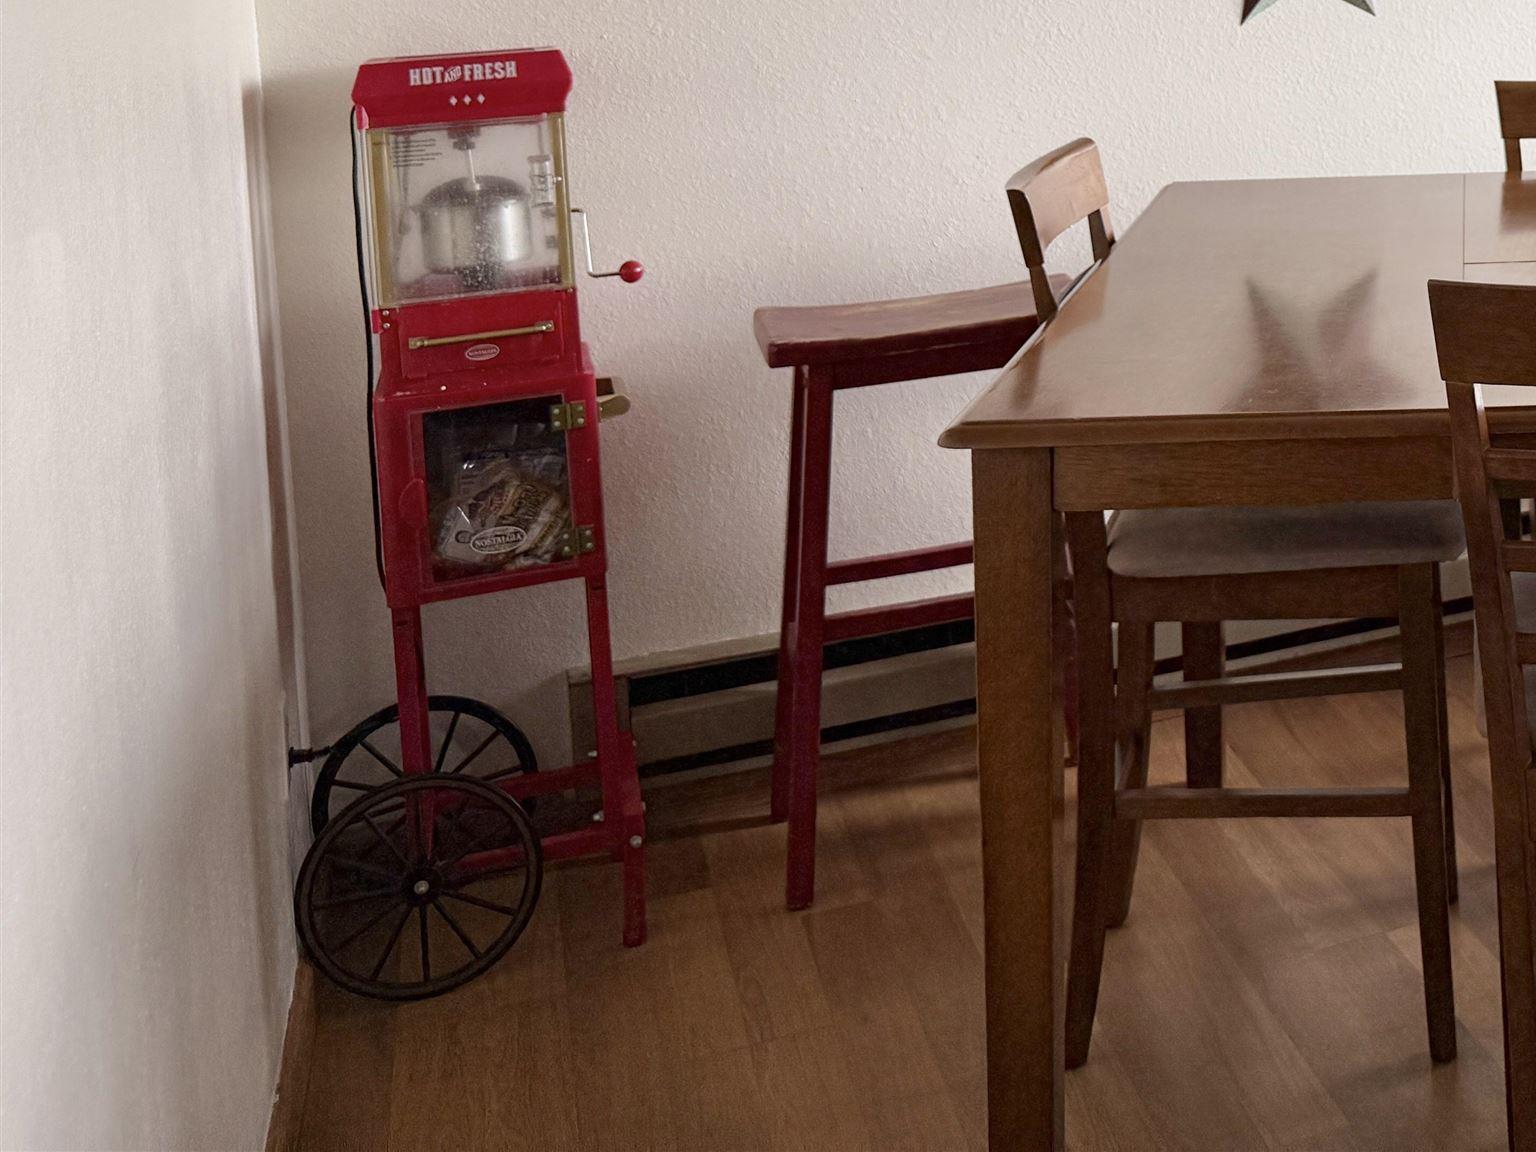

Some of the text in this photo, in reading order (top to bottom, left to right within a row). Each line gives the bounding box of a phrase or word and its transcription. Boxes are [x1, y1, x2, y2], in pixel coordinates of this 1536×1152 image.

[409, 61, 518, 86] HOT AND FRESH
